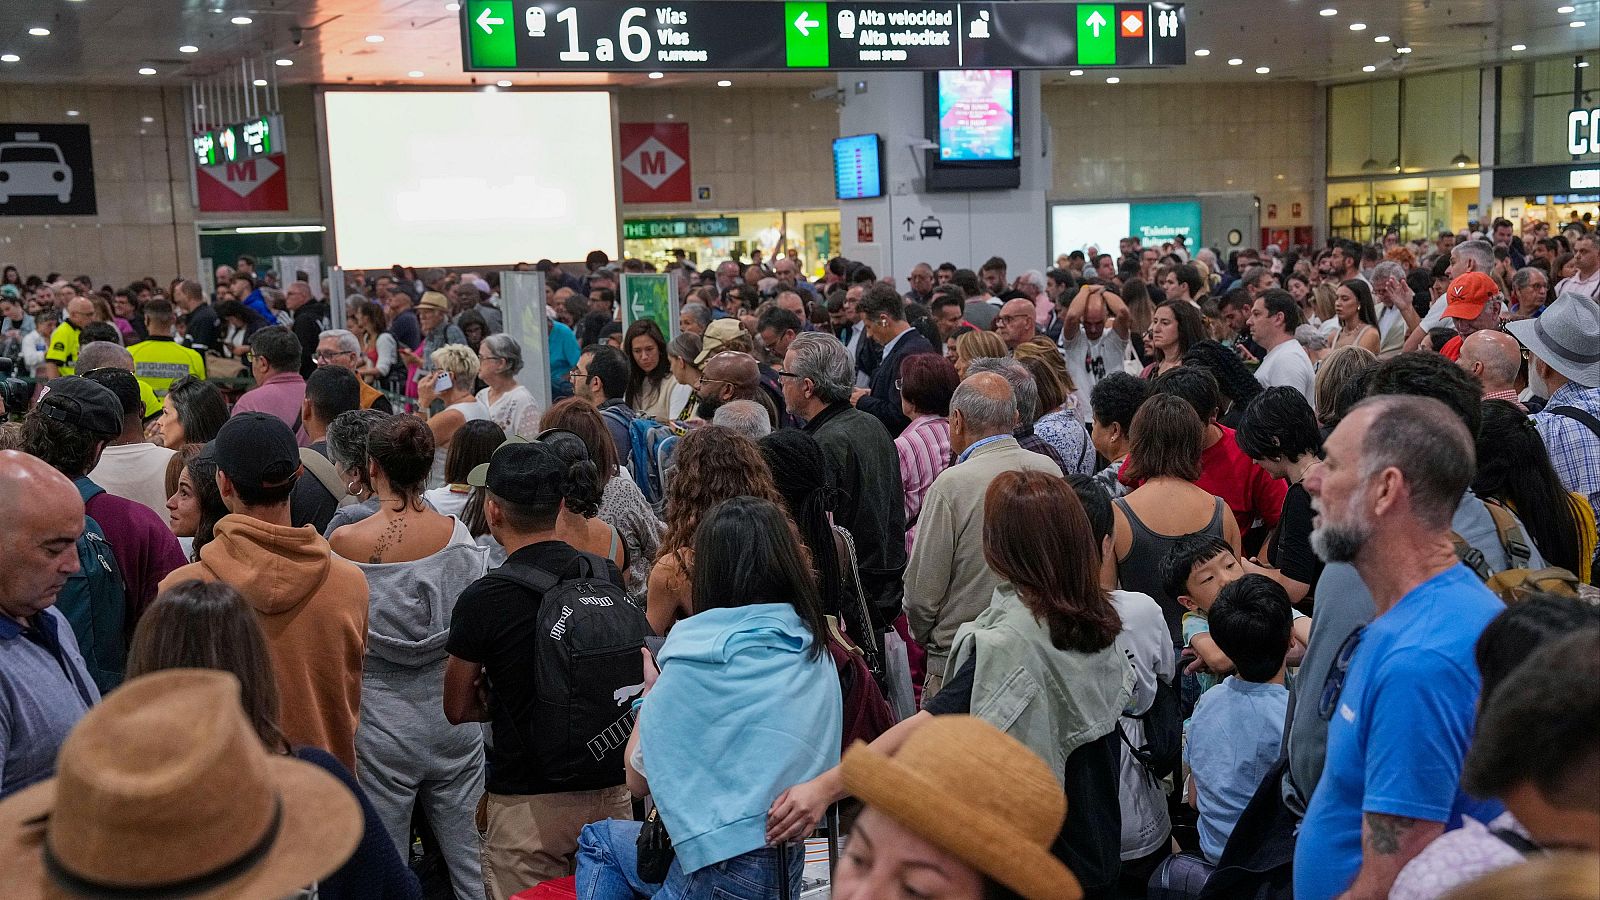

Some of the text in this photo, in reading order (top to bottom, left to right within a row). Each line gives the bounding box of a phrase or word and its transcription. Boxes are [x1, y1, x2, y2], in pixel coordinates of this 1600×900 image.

[656, 7, 687, 25] Vías
[859, 10, 953, 26] Alta velocidad
[556, 7, 651, 62] 1 a 6
[657, 28, 690, 45] Vies
[860, 29, 950, 46] Alta velocitat
[641, 152, 666, 175] M
[624, 223, 647, 237] THE
[650, 221, 686, 236] BOD
[587, 708, 637, 762] PUM
